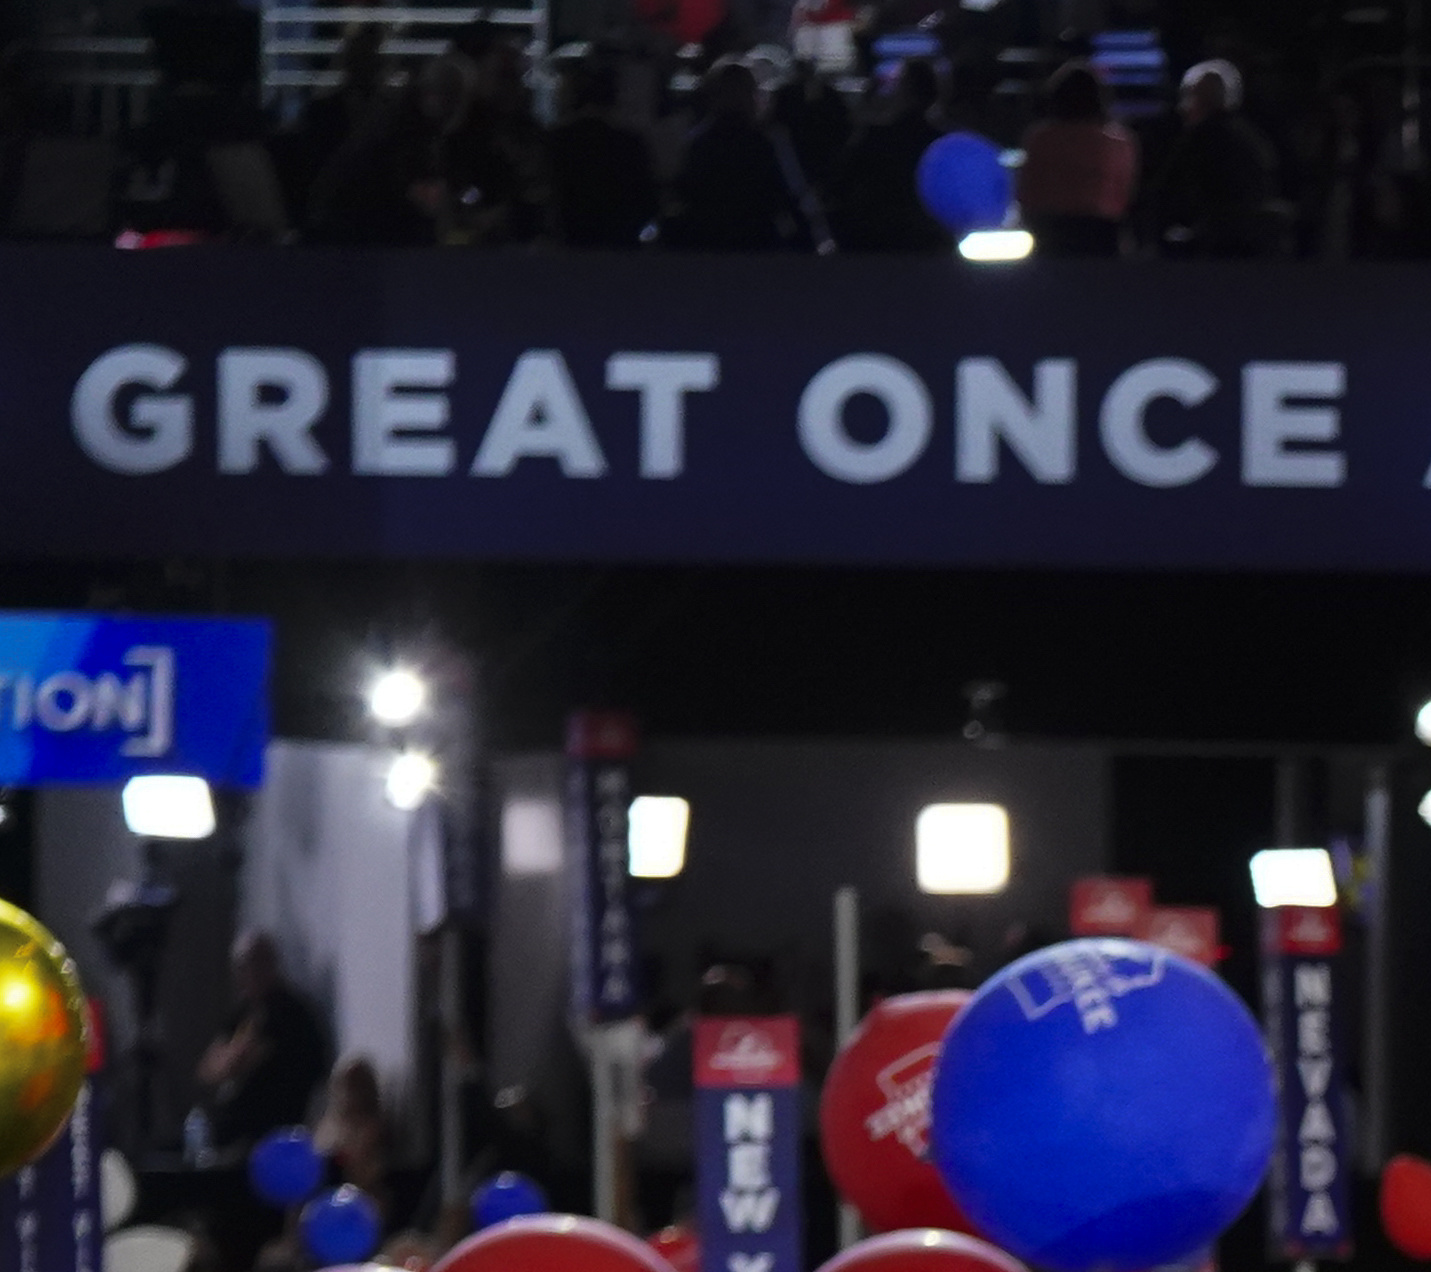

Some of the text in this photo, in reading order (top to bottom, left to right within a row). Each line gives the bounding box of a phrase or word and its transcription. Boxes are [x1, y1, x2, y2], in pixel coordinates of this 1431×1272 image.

[71, 342, 719, 480] GREAT
[796, 353, 1345, 488] ONCE
[0, 645, 174, 757] ION]
[721, 1091, 782, 1235] NEW
